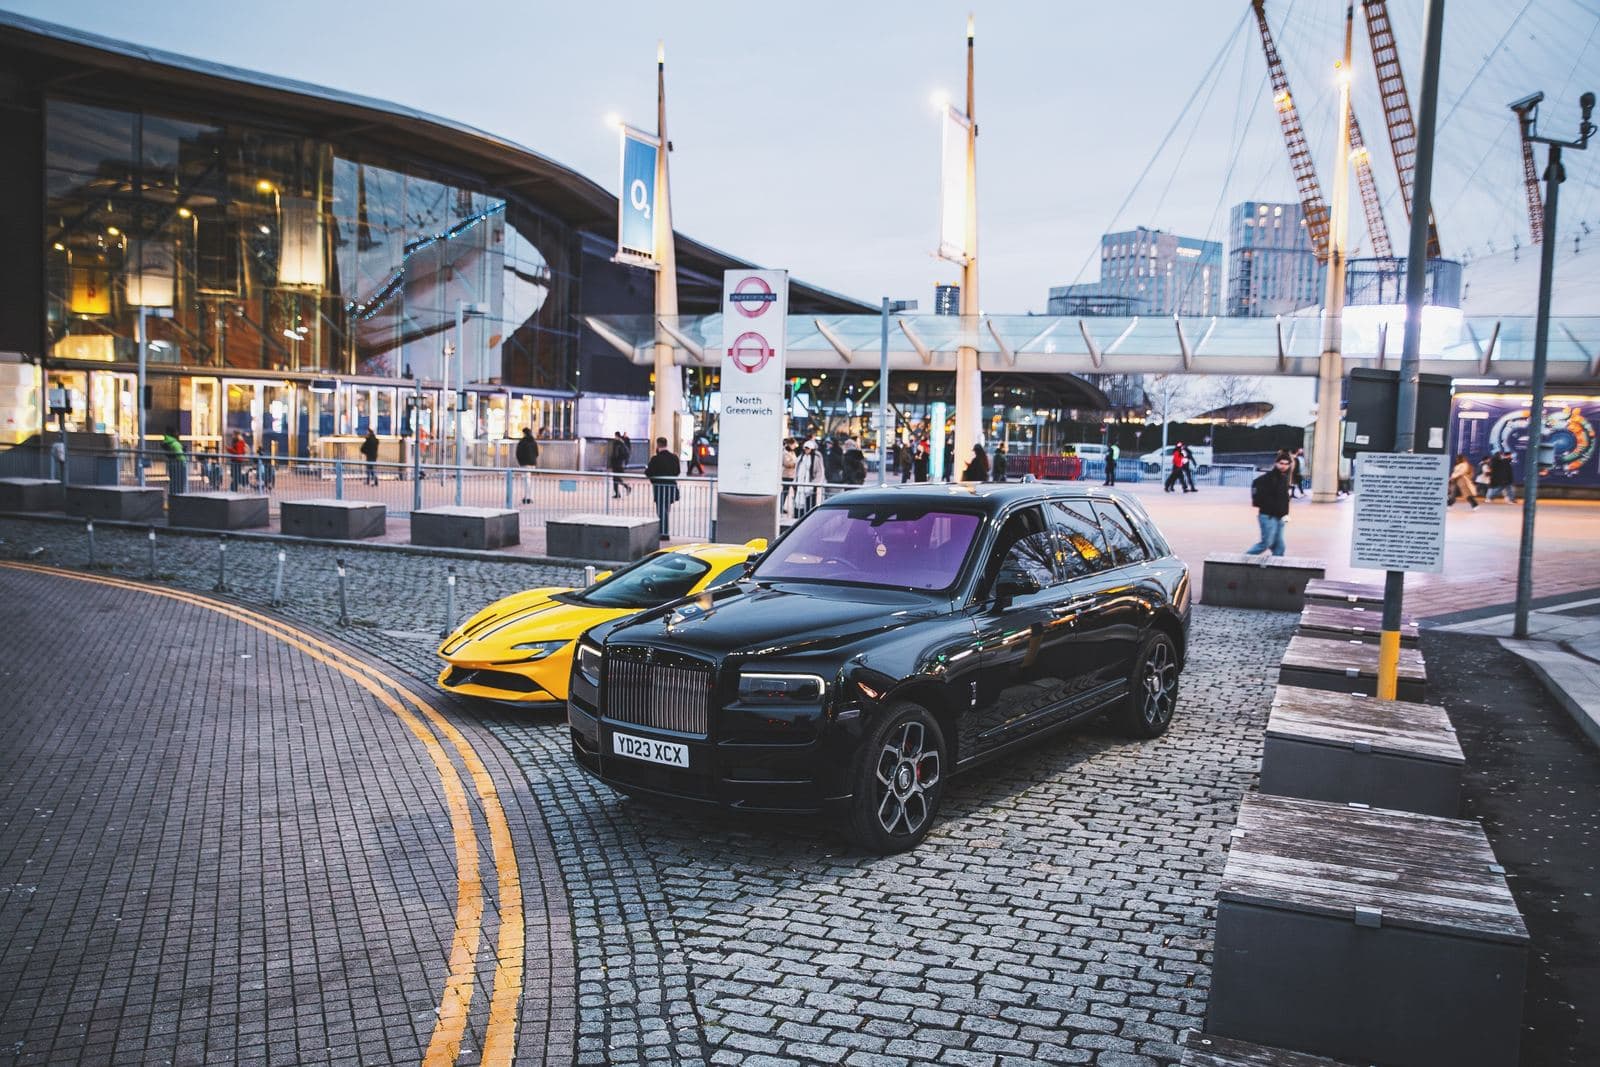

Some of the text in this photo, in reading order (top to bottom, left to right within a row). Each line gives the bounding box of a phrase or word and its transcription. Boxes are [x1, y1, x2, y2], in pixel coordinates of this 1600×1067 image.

[735, 396, 762, 405] North
[726, 406, 773, 416] Greenwich
[618, 735, 682, 764] YD23 XCX
